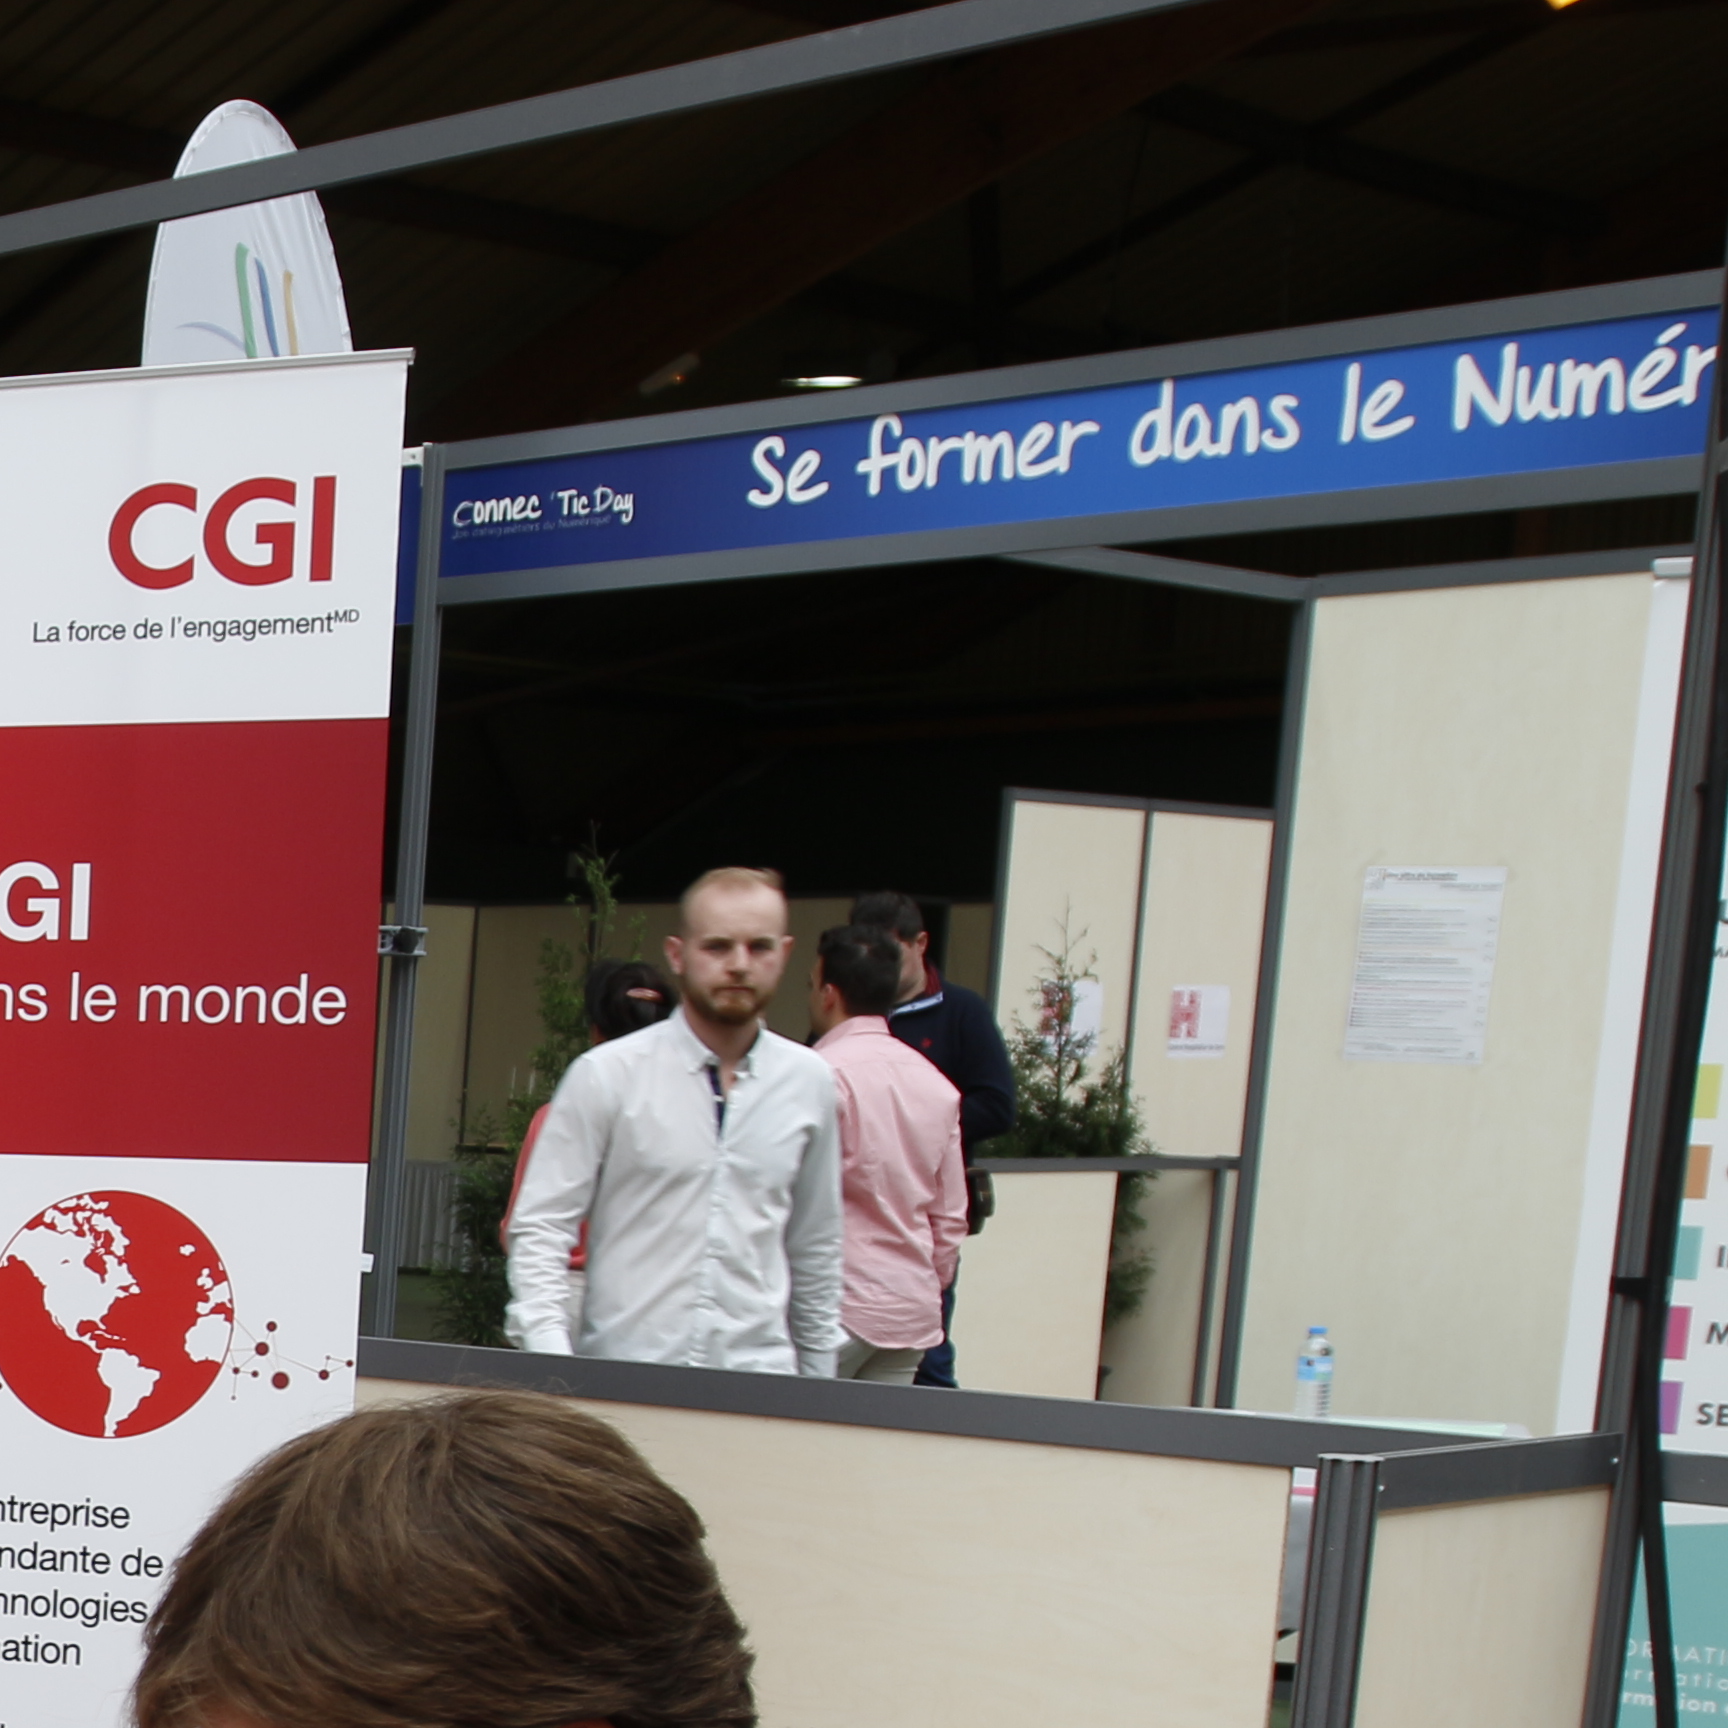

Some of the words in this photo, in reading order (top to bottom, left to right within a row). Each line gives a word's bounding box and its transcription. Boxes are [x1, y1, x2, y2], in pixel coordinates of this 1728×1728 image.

[748, 436, 829, 507] Se
[856, 413, 1100, 496] former
[1130, 378, 1300, 466] dans
[1339, 362, 1416, 443] le
[594, 485, 633, 524] Day
[108, 476, 337, 589] CGI
[32, 622, 61, 643] La
[68, 619, 126, 641] force
[133, 618, 163, 639] de
[71, 972, 116, 1023] le
[139, 974, 346, 1026] monde
[121, 1548, 162, 1578] de
